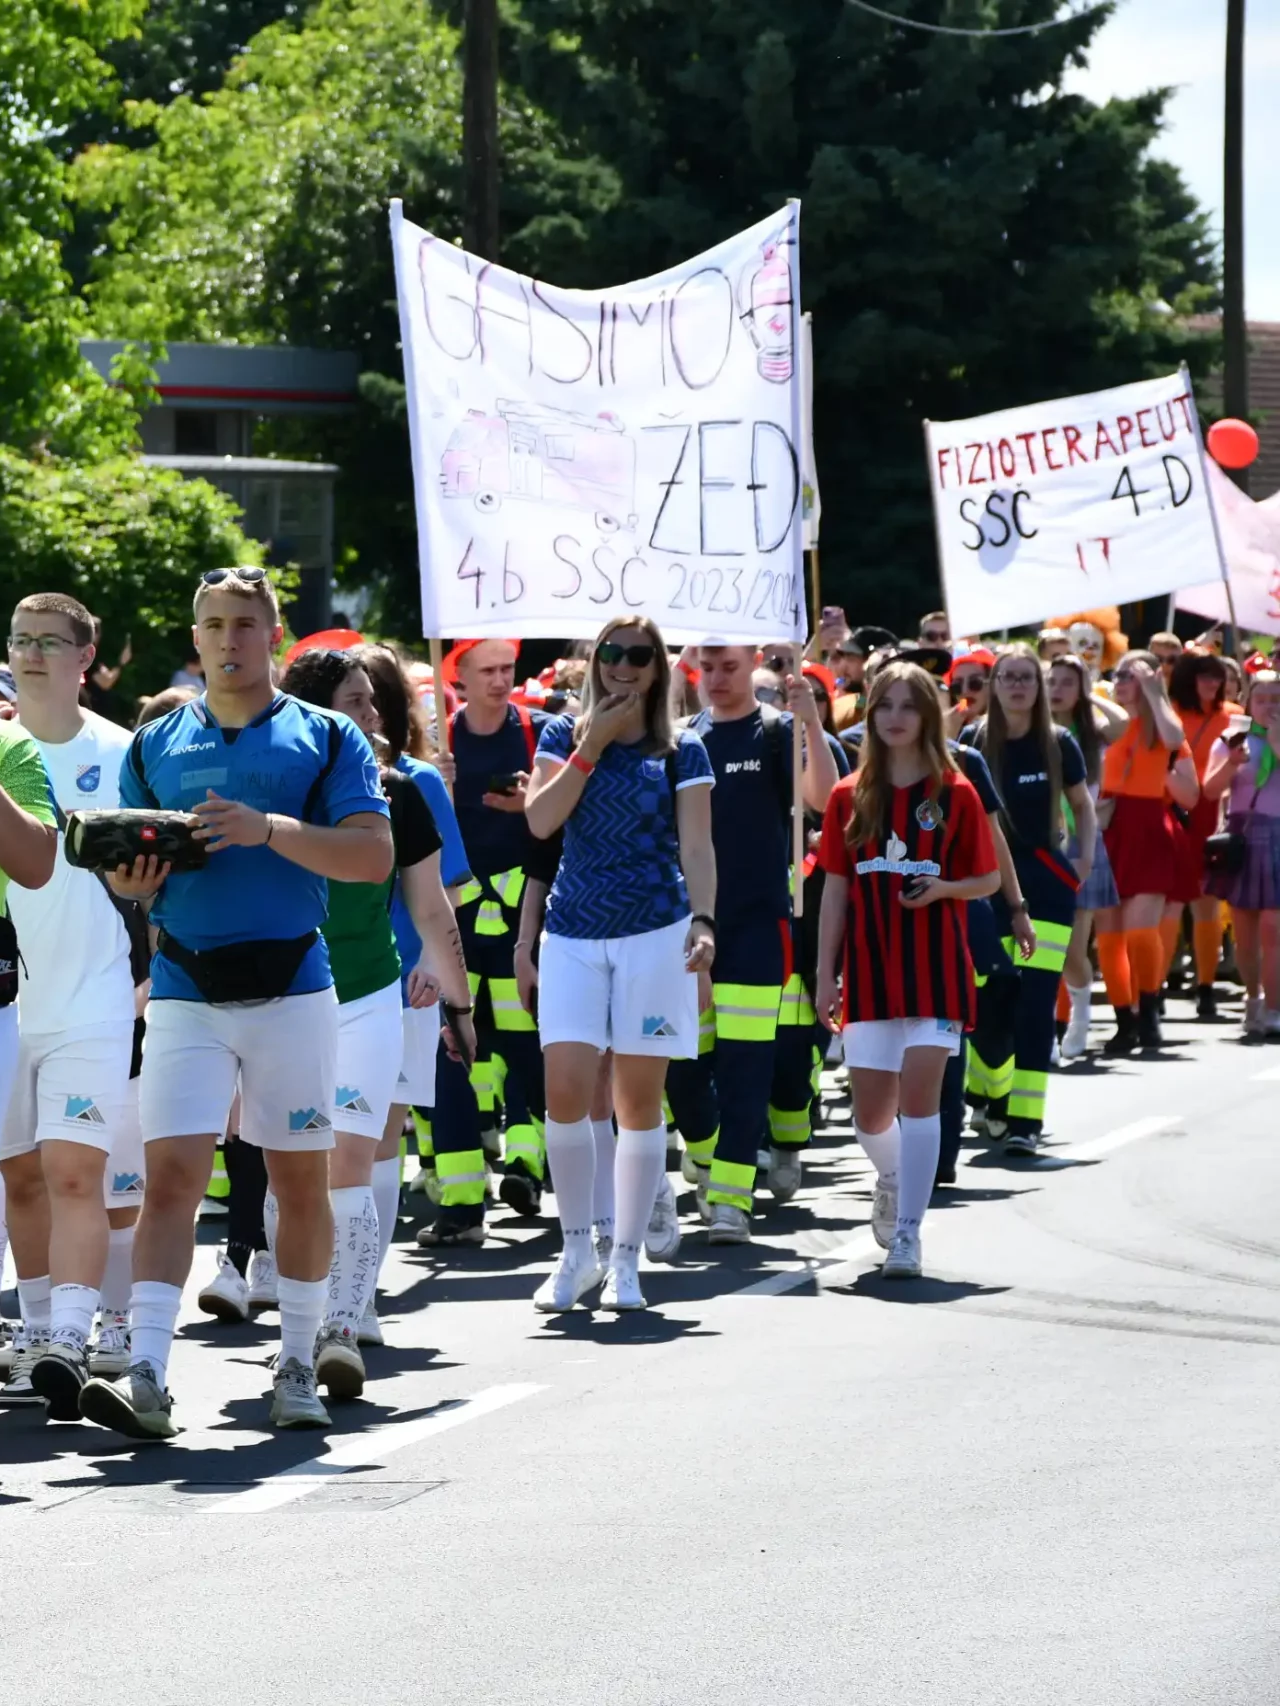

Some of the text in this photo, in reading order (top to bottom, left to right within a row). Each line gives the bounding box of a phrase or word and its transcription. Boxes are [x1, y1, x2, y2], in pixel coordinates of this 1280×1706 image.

[418, 236, 733, 390] GASIMO
[937, 392, 1194, 490] FIZIOTERAPEUT
[959, 481, 1038, 551] SŠČ
[456, 536, 524, 610] 4.b
[550, 533, 650, 608] SŠČ
[170, 741, 216, 757] GIVOVA
